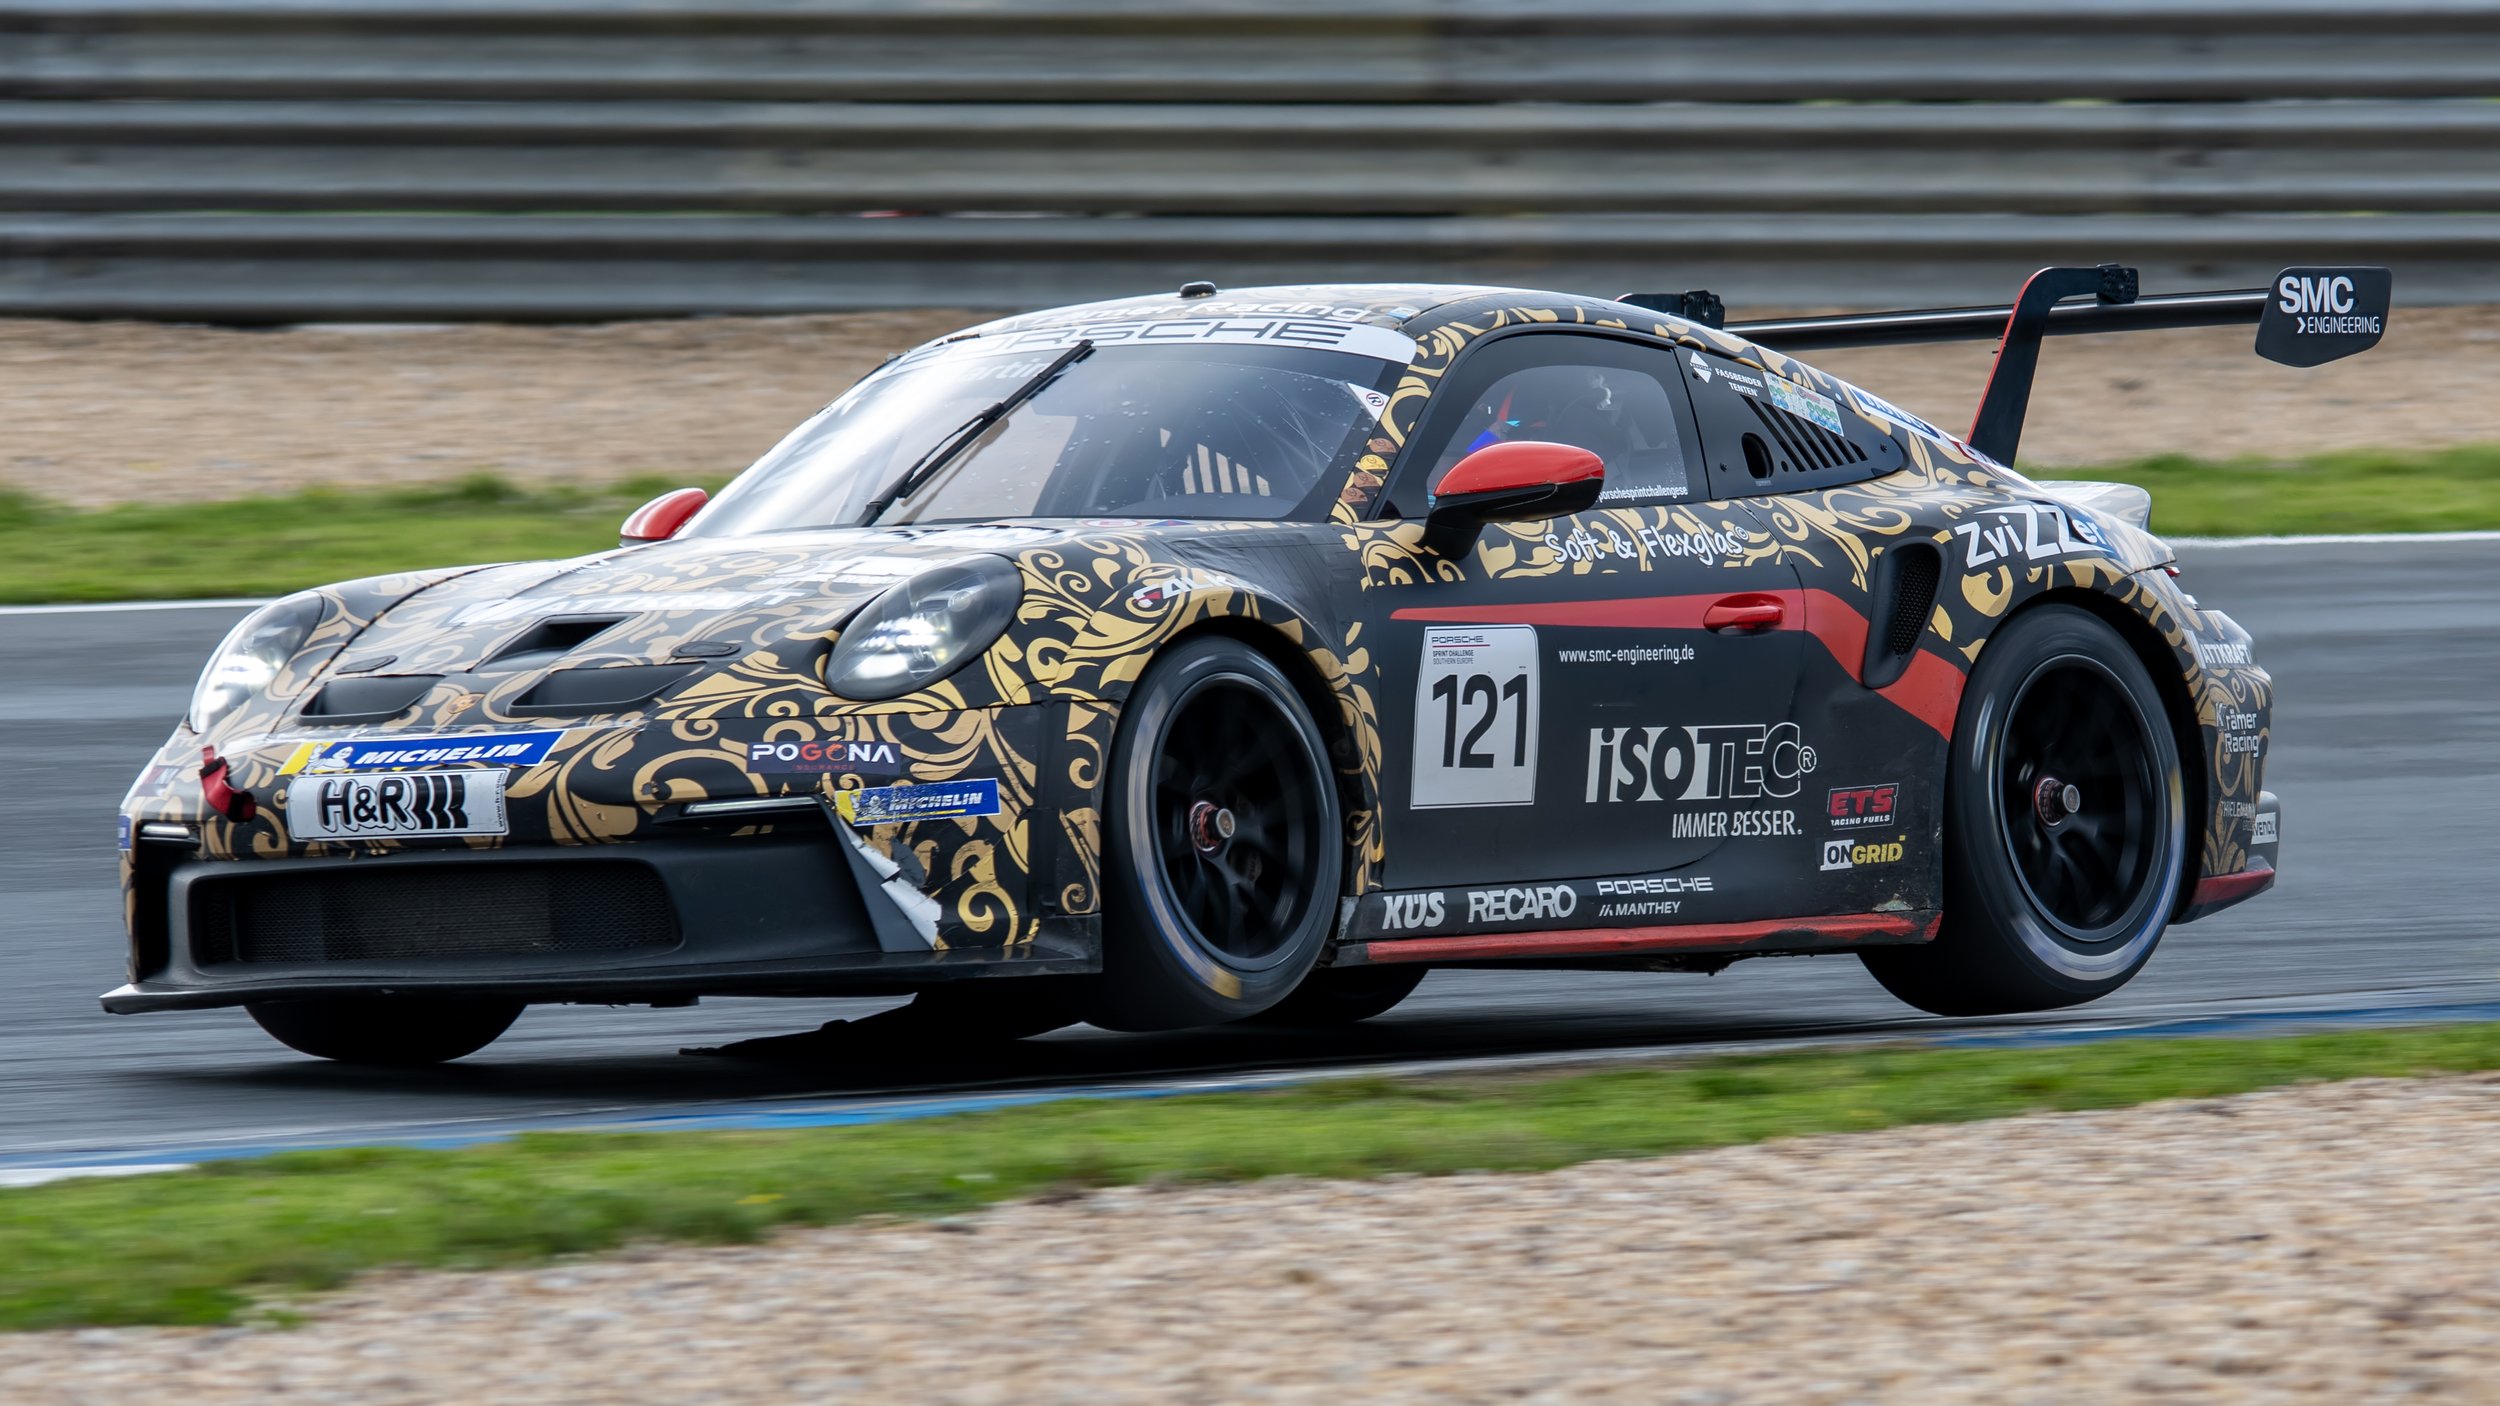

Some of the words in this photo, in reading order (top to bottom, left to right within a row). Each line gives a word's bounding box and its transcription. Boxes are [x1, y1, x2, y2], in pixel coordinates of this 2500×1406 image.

[2279, 276, 2354, 314] SMC
[2307, 316, 2380, 334] ENGINEERING
[1714, 367, 1764, 389] FASSBENDER
[1728, 381, 1758, 397] TENTEN
[1544, 527, 1605, 563] Soft
[1608, 529, 1638, 560] &
[1431, 635, 1484, 645] PORSCHE
[1432, 649, 1448, 658] SPRINT
[1449, 649, 1474, 657] CHALLENGE
[1558, 644, 1695, 666] www.smc-engineering.de
[1432, 673, 1528, 769] 121
[2215, 702, 2257, 731] Krämer
[354, 743, 534, 765] MICHELIN
[752, 742, 896, 764] POGONA
[2224, 731, 2259, 758] Racing
[1830, 787, 1895, 816] ETS
[1672, 812, 1728, 839] IMMER
[1731, 810, 1803, 837] BESSER.
[1862, 814, 1891, 824] FUELS
[1596, 876, 1714, 896] PORSCHE
[1382, 891, 1446, 930] KÜS
[1467, 884, 1578, 924] RECARO
[1615, 901, 1681, 917] MANTHEY
